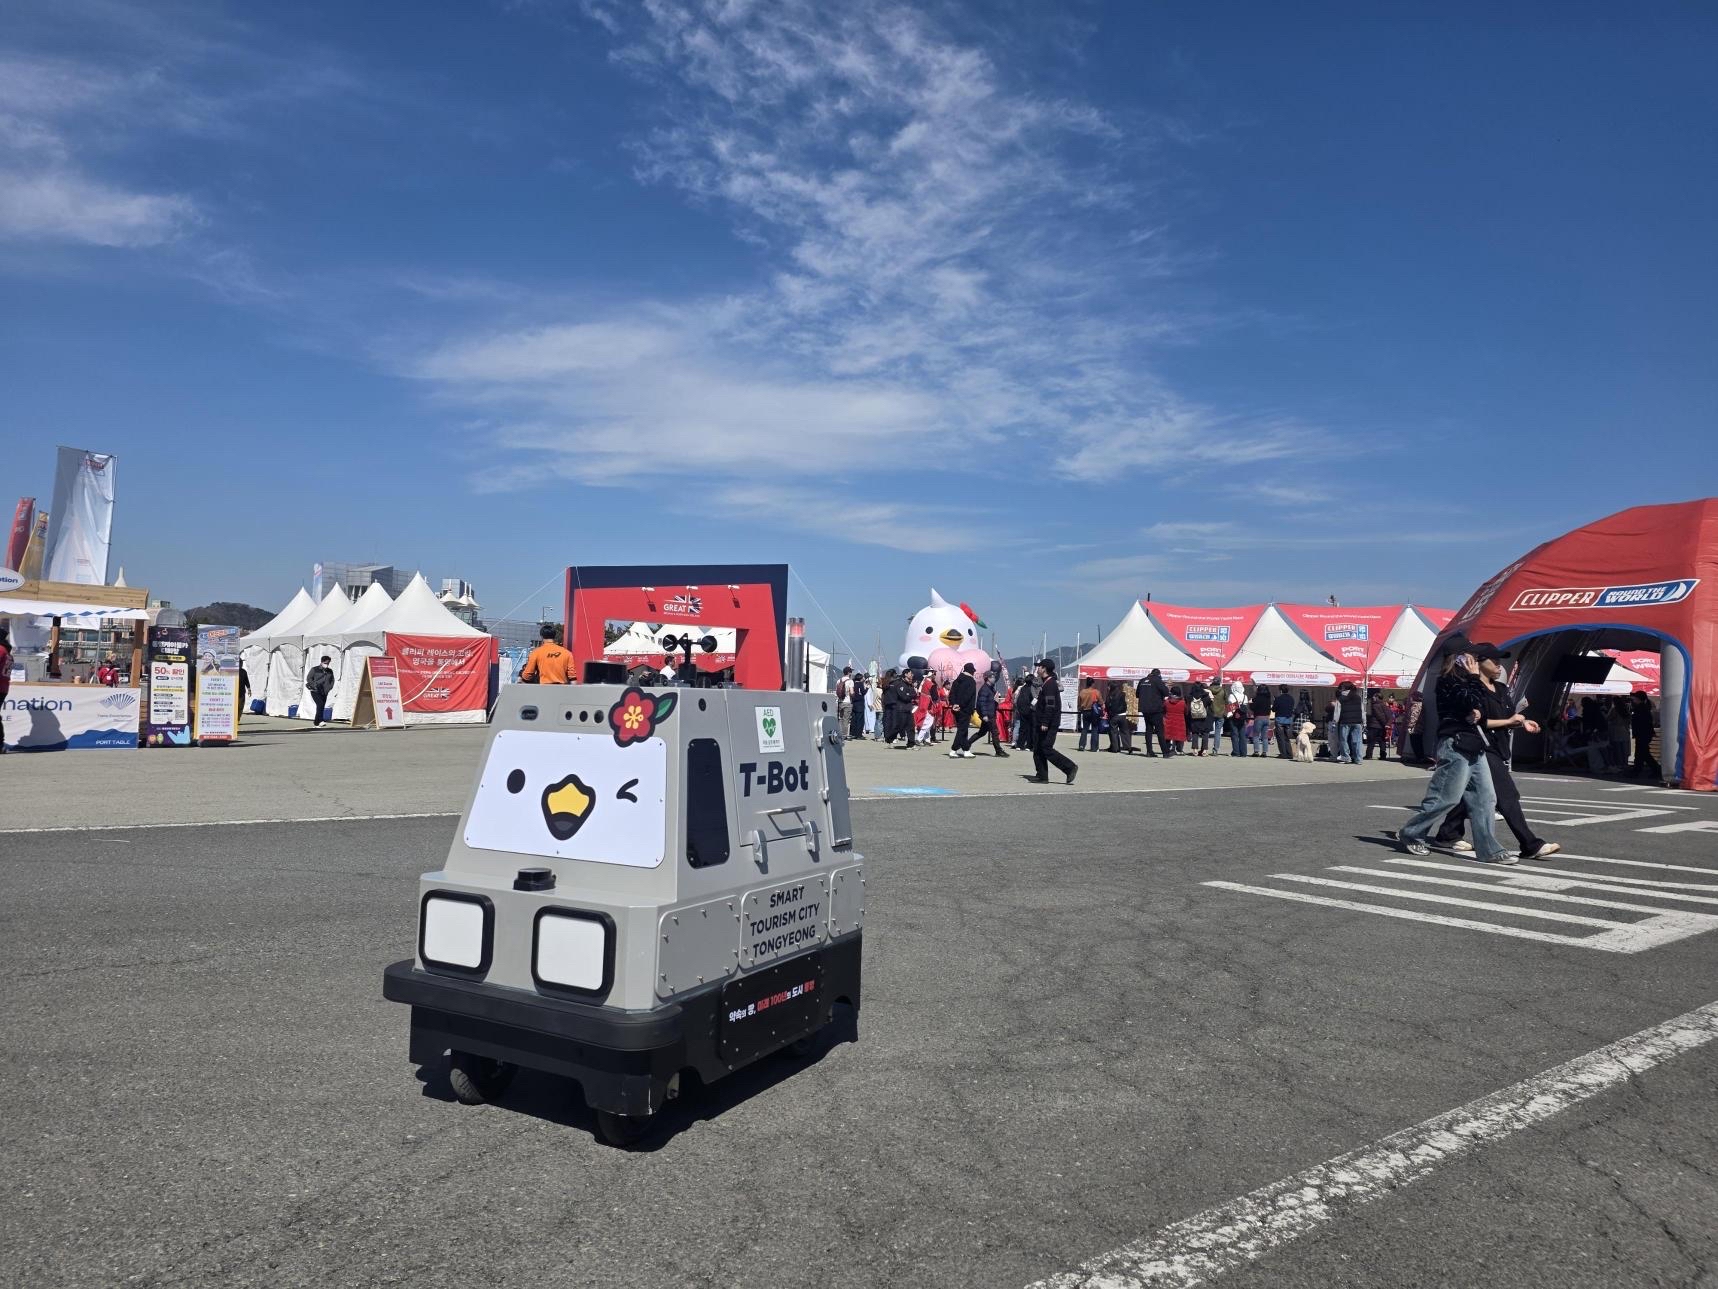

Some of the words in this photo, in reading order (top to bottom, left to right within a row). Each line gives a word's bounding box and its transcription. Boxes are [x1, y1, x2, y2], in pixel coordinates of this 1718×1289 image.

[1520, 591, 1596, 606] CLIPPER
[1608, 589, 1647, 597] ROUND
[1647, 586, 1667, 594] THE
[1604, 592, 1665, 604] WORLD
[663, 604, 687, 612] GREAT
[412, 657, 435, 666] 영국을
[427, 648, 456, 657] 레이스의
[763, 709, 774, 717] AED
[740, 760, 809, 797] T-Bot
[770, 886, 805, 908] SMART
[750, 909, 796, 937] TOURISM
[798, 902, 820, 921] CITY
[752, 924, 816, 958] TONGYEONG
[729, 1009, 747, 1022] 약속의
[757, 997, 770, 1012] 미래
[792, 984, 804, 998] 도시
